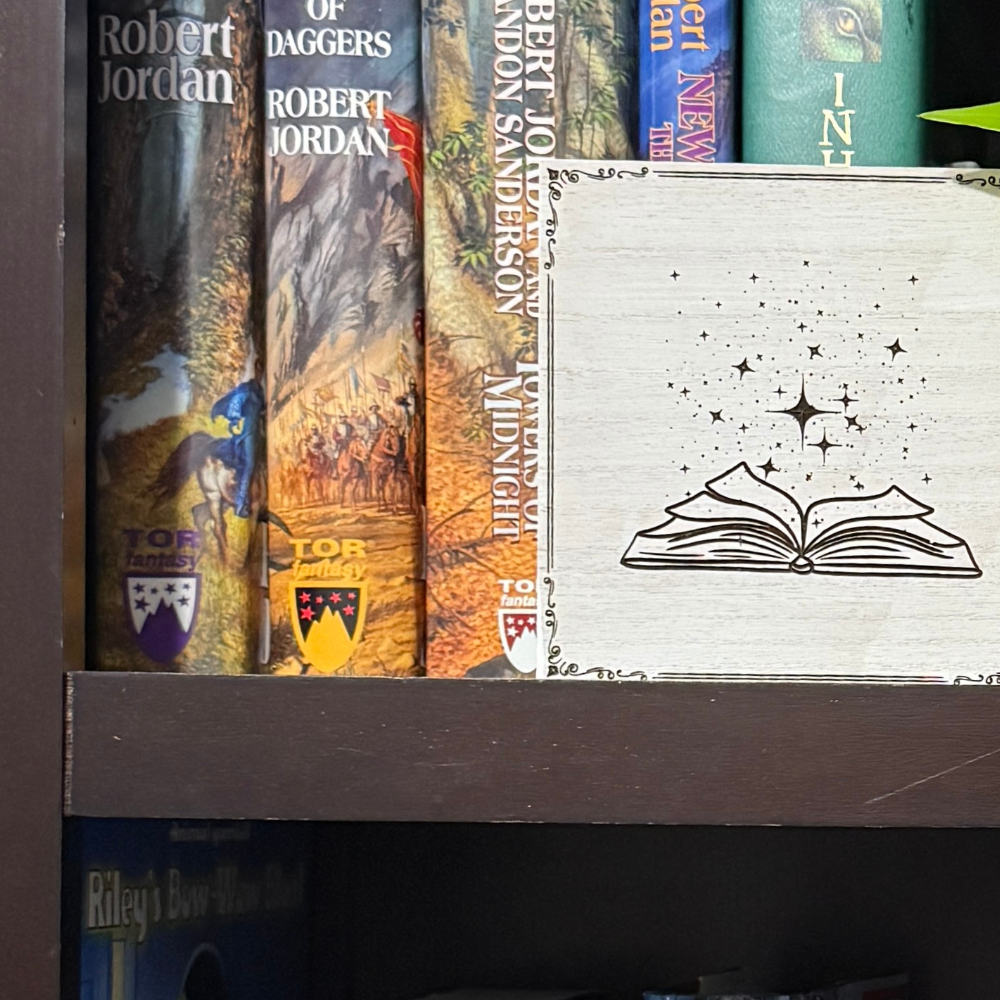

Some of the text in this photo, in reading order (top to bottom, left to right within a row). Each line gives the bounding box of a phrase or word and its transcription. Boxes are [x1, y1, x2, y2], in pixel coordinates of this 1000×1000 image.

[306, 0, 346, 21] OF
[679, 0, 711, 52] ert
[98, 10, 235, 58] Robert
[267, 28, 391, 58] DAGGERS
[98, 56, 235, 104] Jordan
[268, 87, 391, 119] ROBERT
[677, 70, 716, 163] NEW
[269, 125, 390, 157] JORDAN
[494, 113, 524, 316] SANDERSON
[484, 375, 522, 543] MIDNIGHT
[122, 529, 198, 548] TOR
[289, 539, 367, 558] TOR
[127, 552, 199, 573] fantasy
[292, 559, 367, 580] fantasy
[88, 866, 162, 943] Riley's
